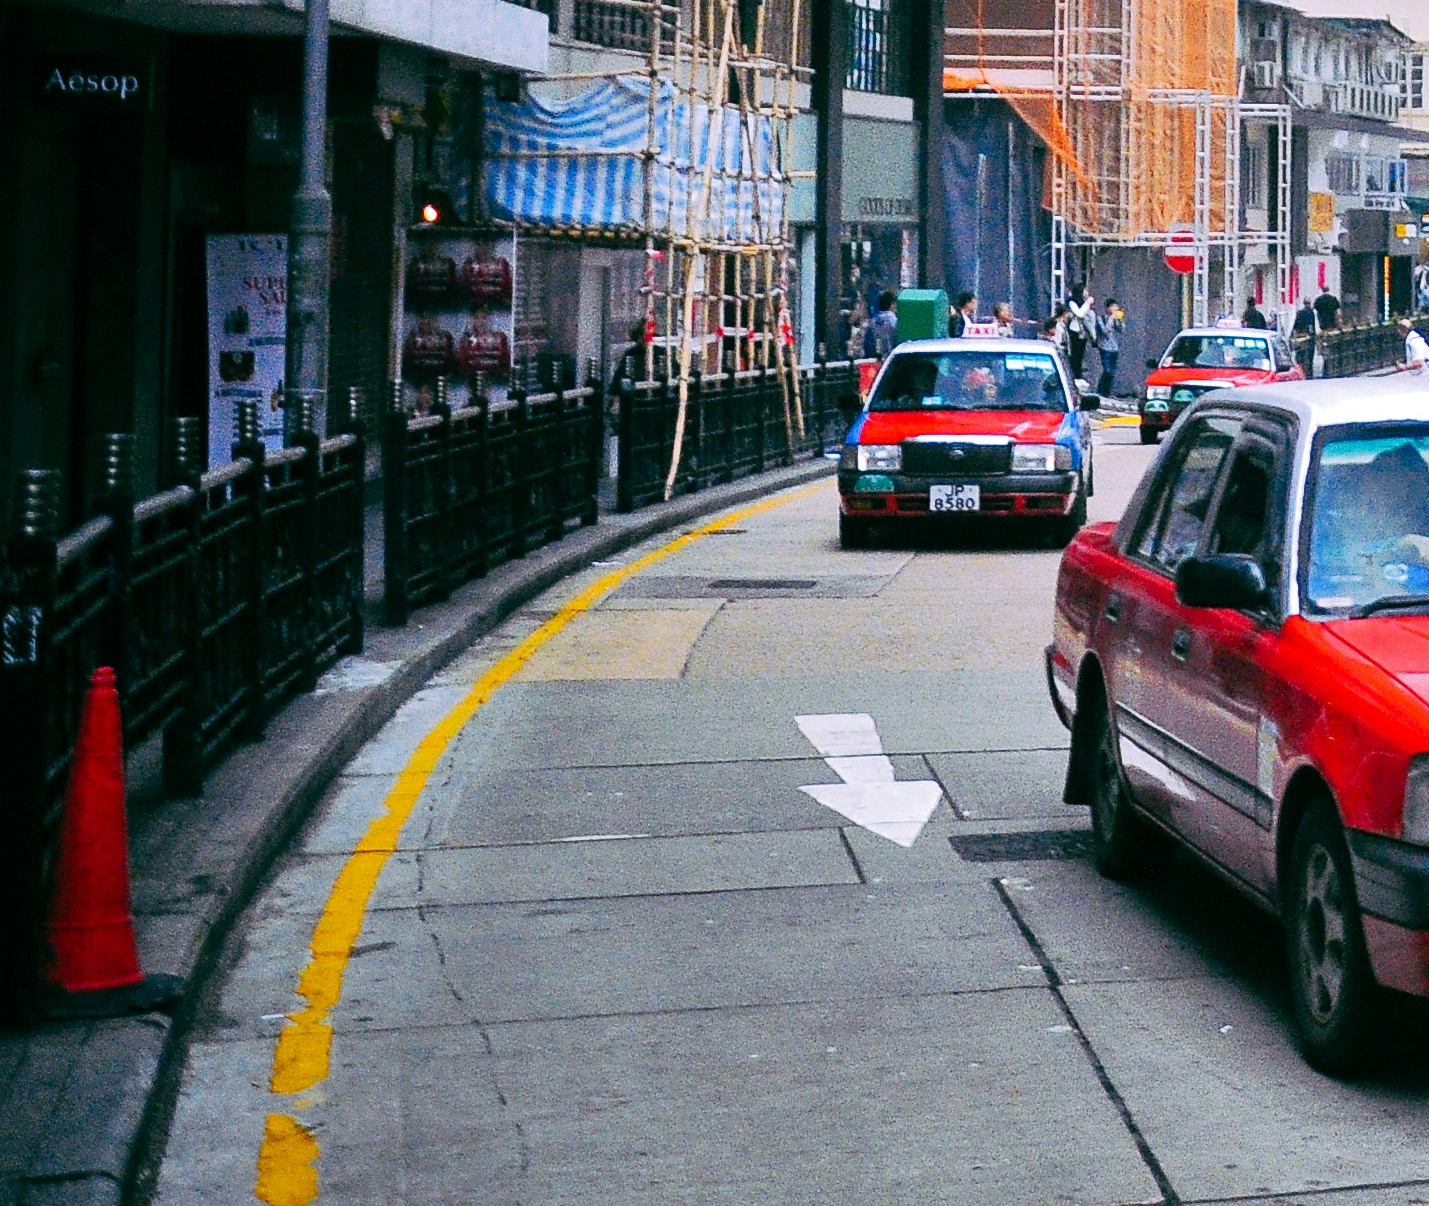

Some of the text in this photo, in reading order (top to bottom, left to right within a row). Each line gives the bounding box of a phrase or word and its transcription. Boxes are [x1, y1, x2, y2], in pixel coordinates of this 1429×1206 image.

[45, 67, 139, 99] Aesop
[967, 326, 996, 335] TAXI
[944, 484, 965, 497] JP
